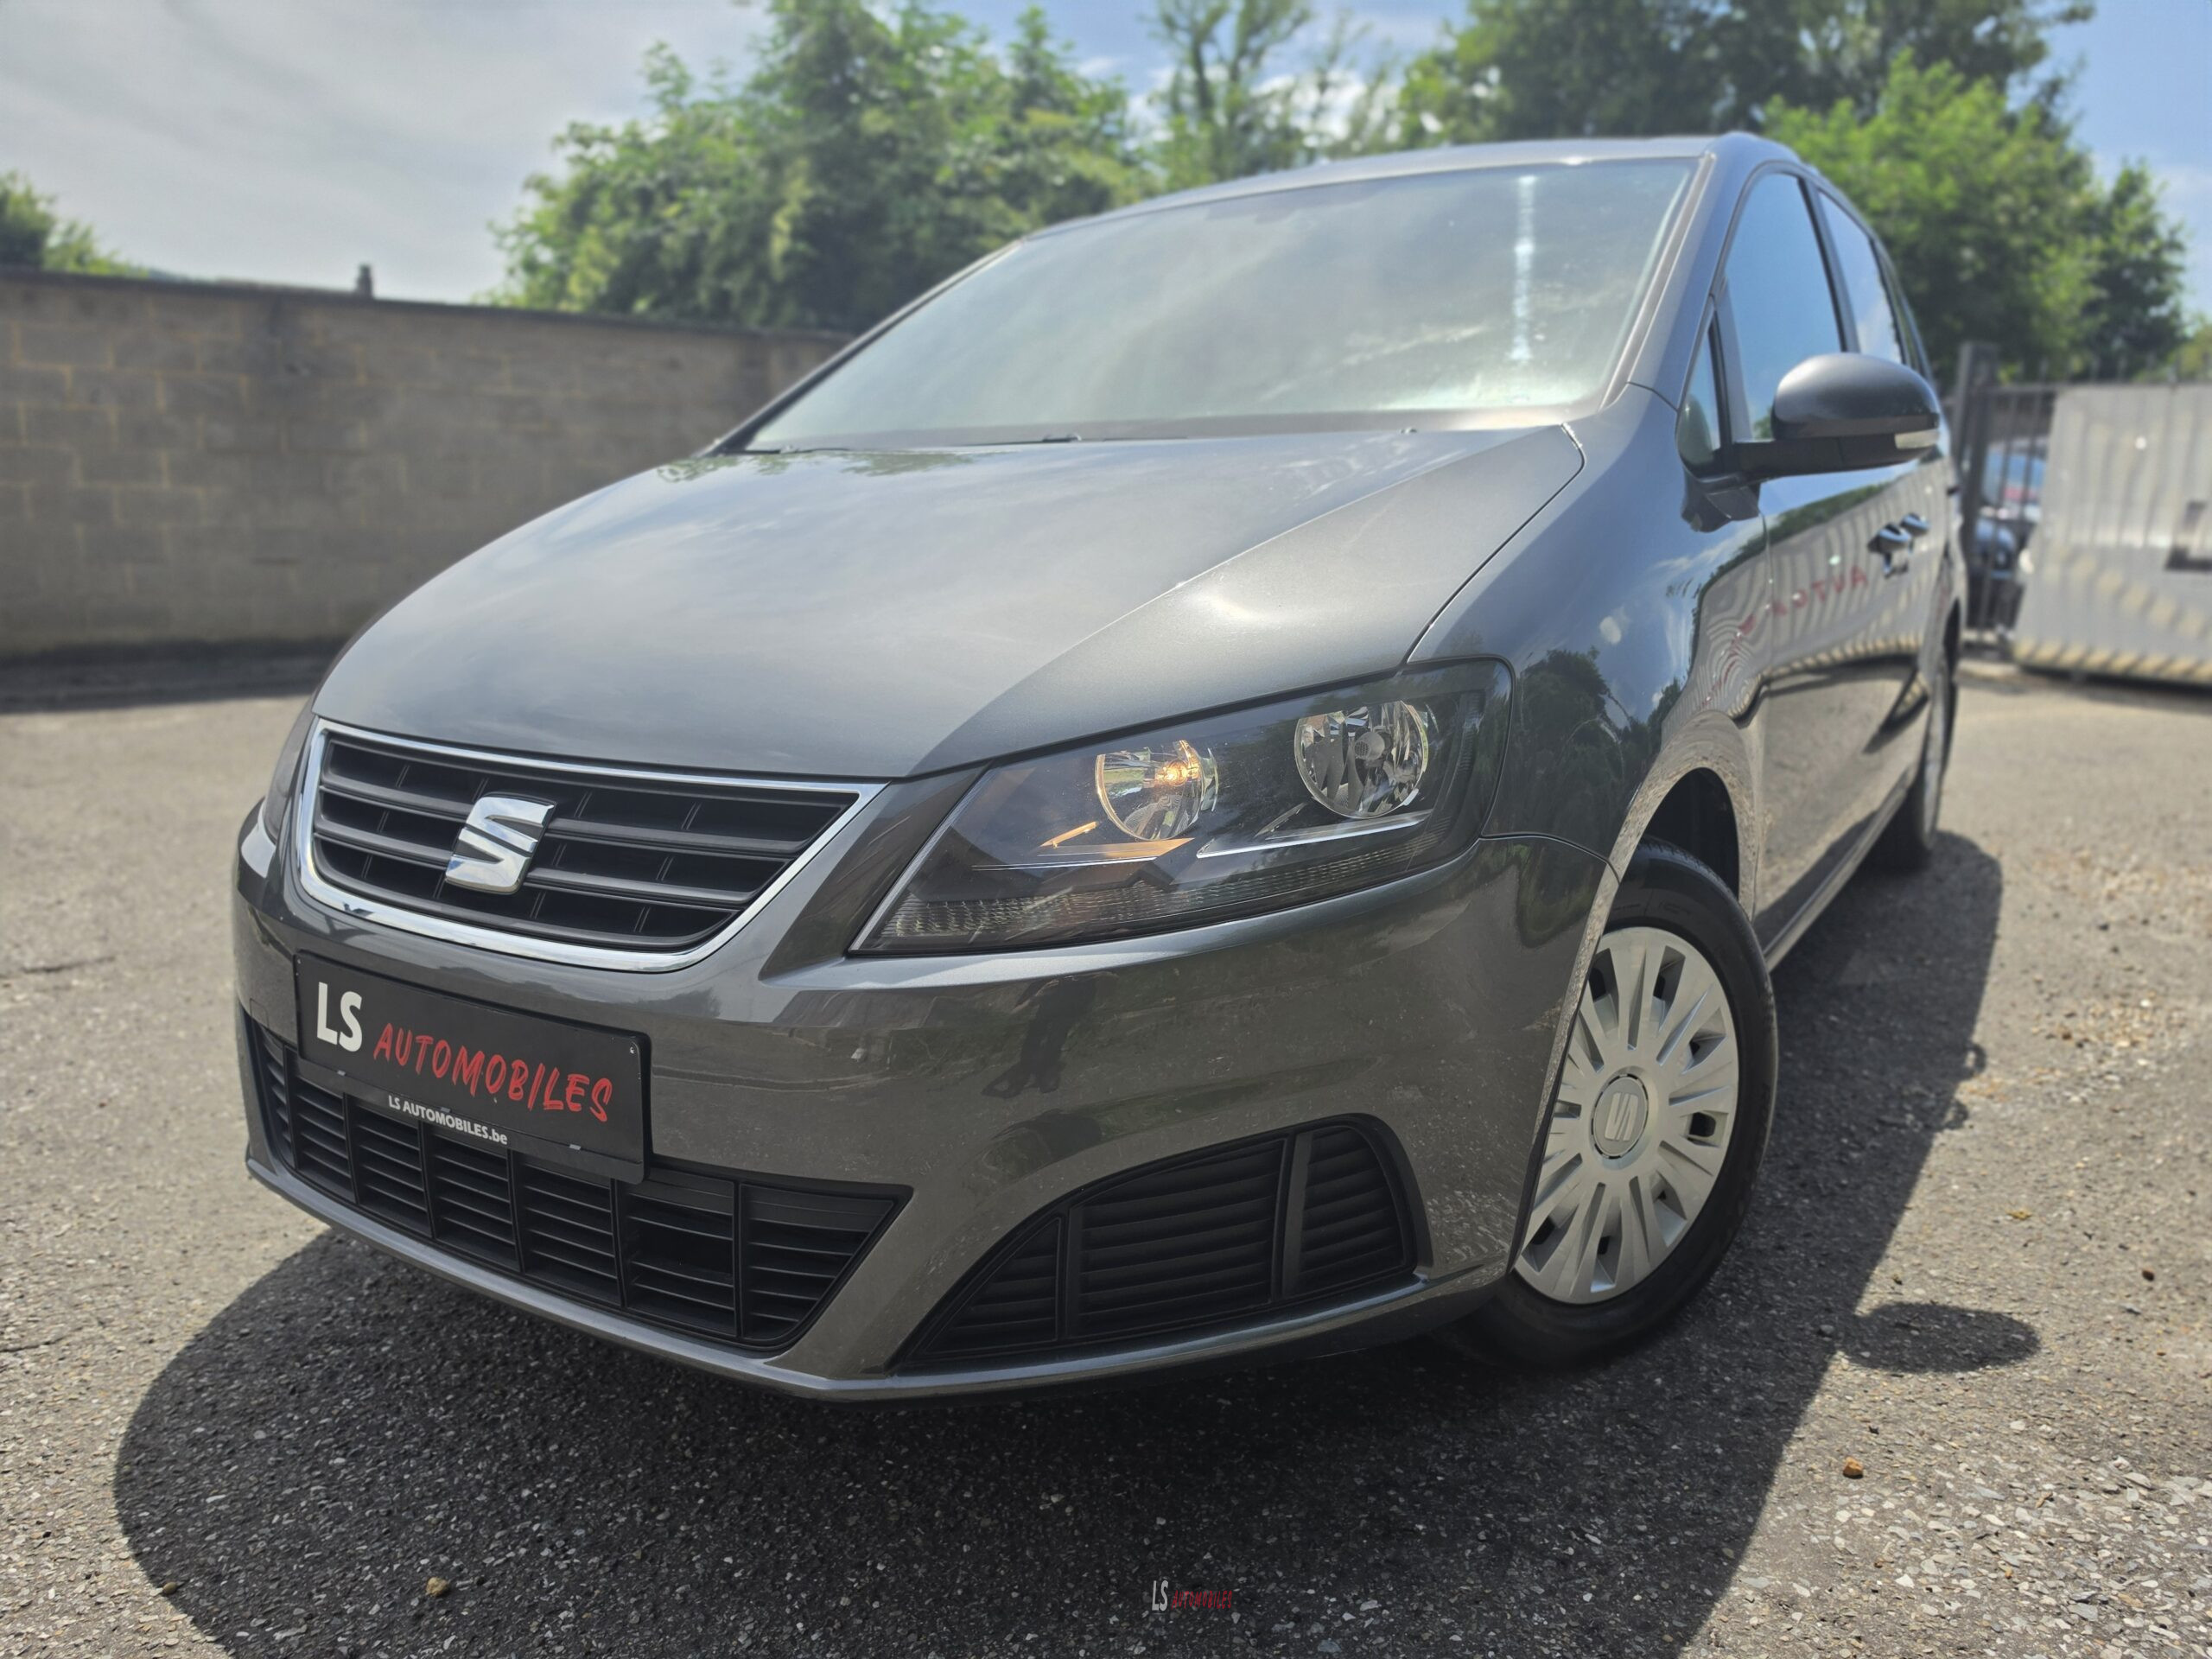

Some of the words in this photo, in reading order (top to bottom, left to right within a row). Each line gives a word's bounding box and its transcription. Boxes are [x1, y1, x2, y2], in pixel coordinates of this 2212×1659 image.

[316, 982, 363, 1052] LS
[373, 1022, 613, 1122] AUTOMOBILES
[388, 1095, 401, 1110] LS
[402, 1100, 508, 1145] AUTOMOBILES.be
